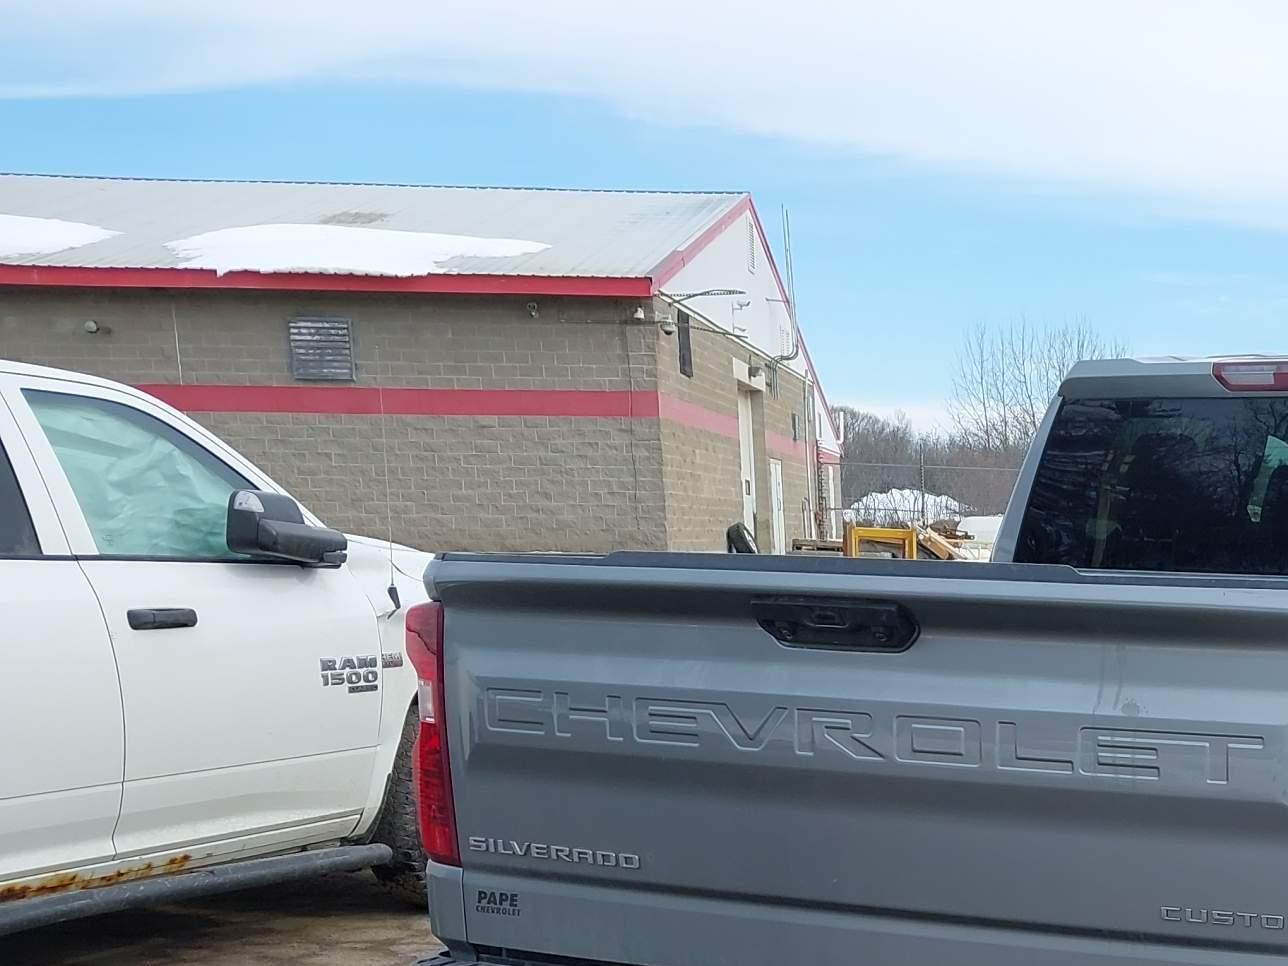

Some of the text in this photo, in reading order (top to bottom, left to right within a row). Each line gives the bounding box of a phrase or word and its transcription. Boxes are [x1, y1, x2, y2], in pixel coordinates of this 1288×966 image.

[320, 655, 377, 671] RAM
[321, 669, 378, 686] 1500
[484, 686, 1265, 785] CHEVROLET
[469, 836, 641, 869] SILVERADO
[477, 890, 519, 907] PAPE
[475, 904, 521, 917] CHEVROLET
